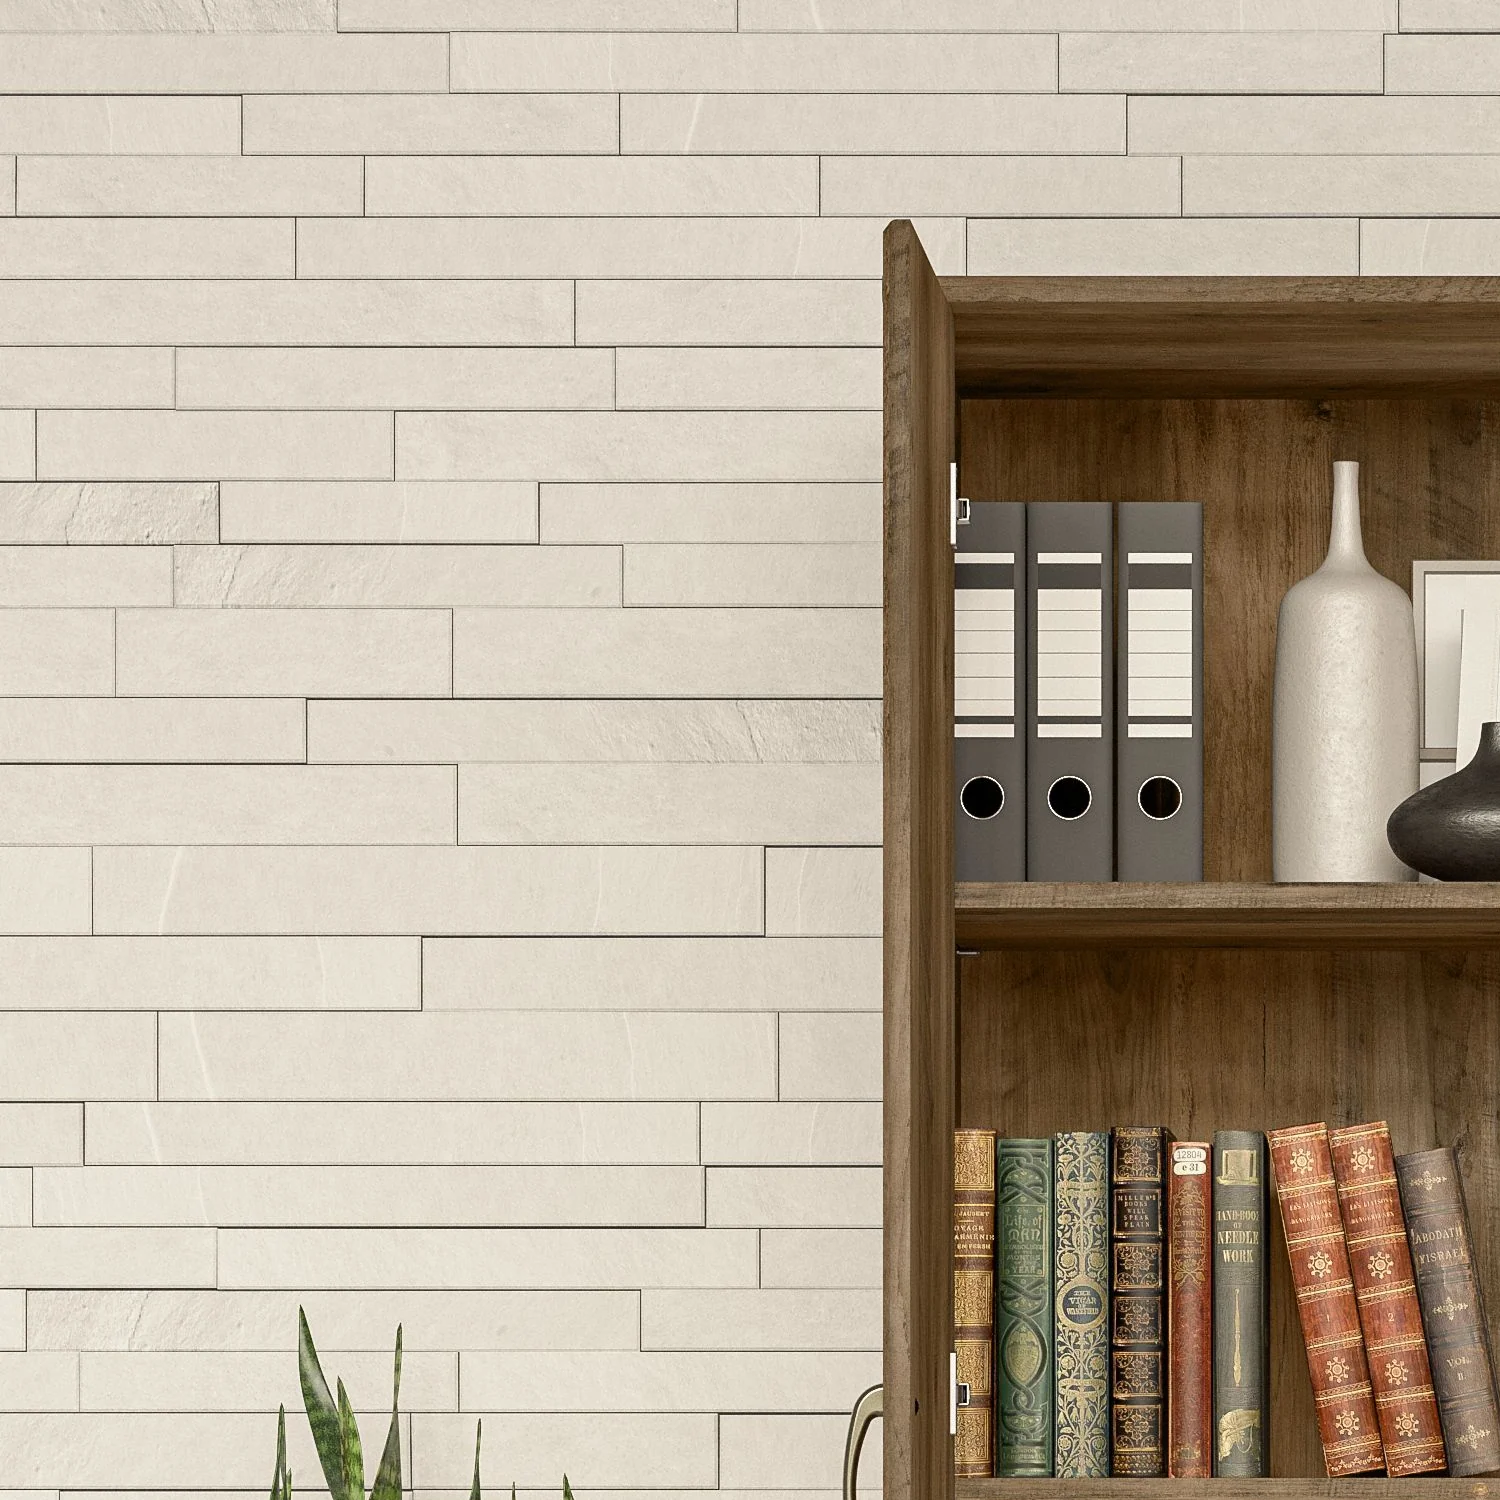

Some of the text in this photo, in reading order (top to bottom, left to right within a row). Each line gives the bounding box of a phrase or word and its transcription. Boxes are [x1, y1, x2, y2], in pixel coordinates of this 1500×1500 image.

[1176, 1150, 1202, 1160] 12804
[1189, 1163, 1199, 1172] 31
[1217, 1230, 1259, 1245] NEEDLE
[1222, 1249, 1254, 1263] WORK
[1418, 1247, 1467, 1264] YISRAEL
[1068, 1296, 1097, 1305] VICAR
[1387, 1312, 1395, 1322] 2
